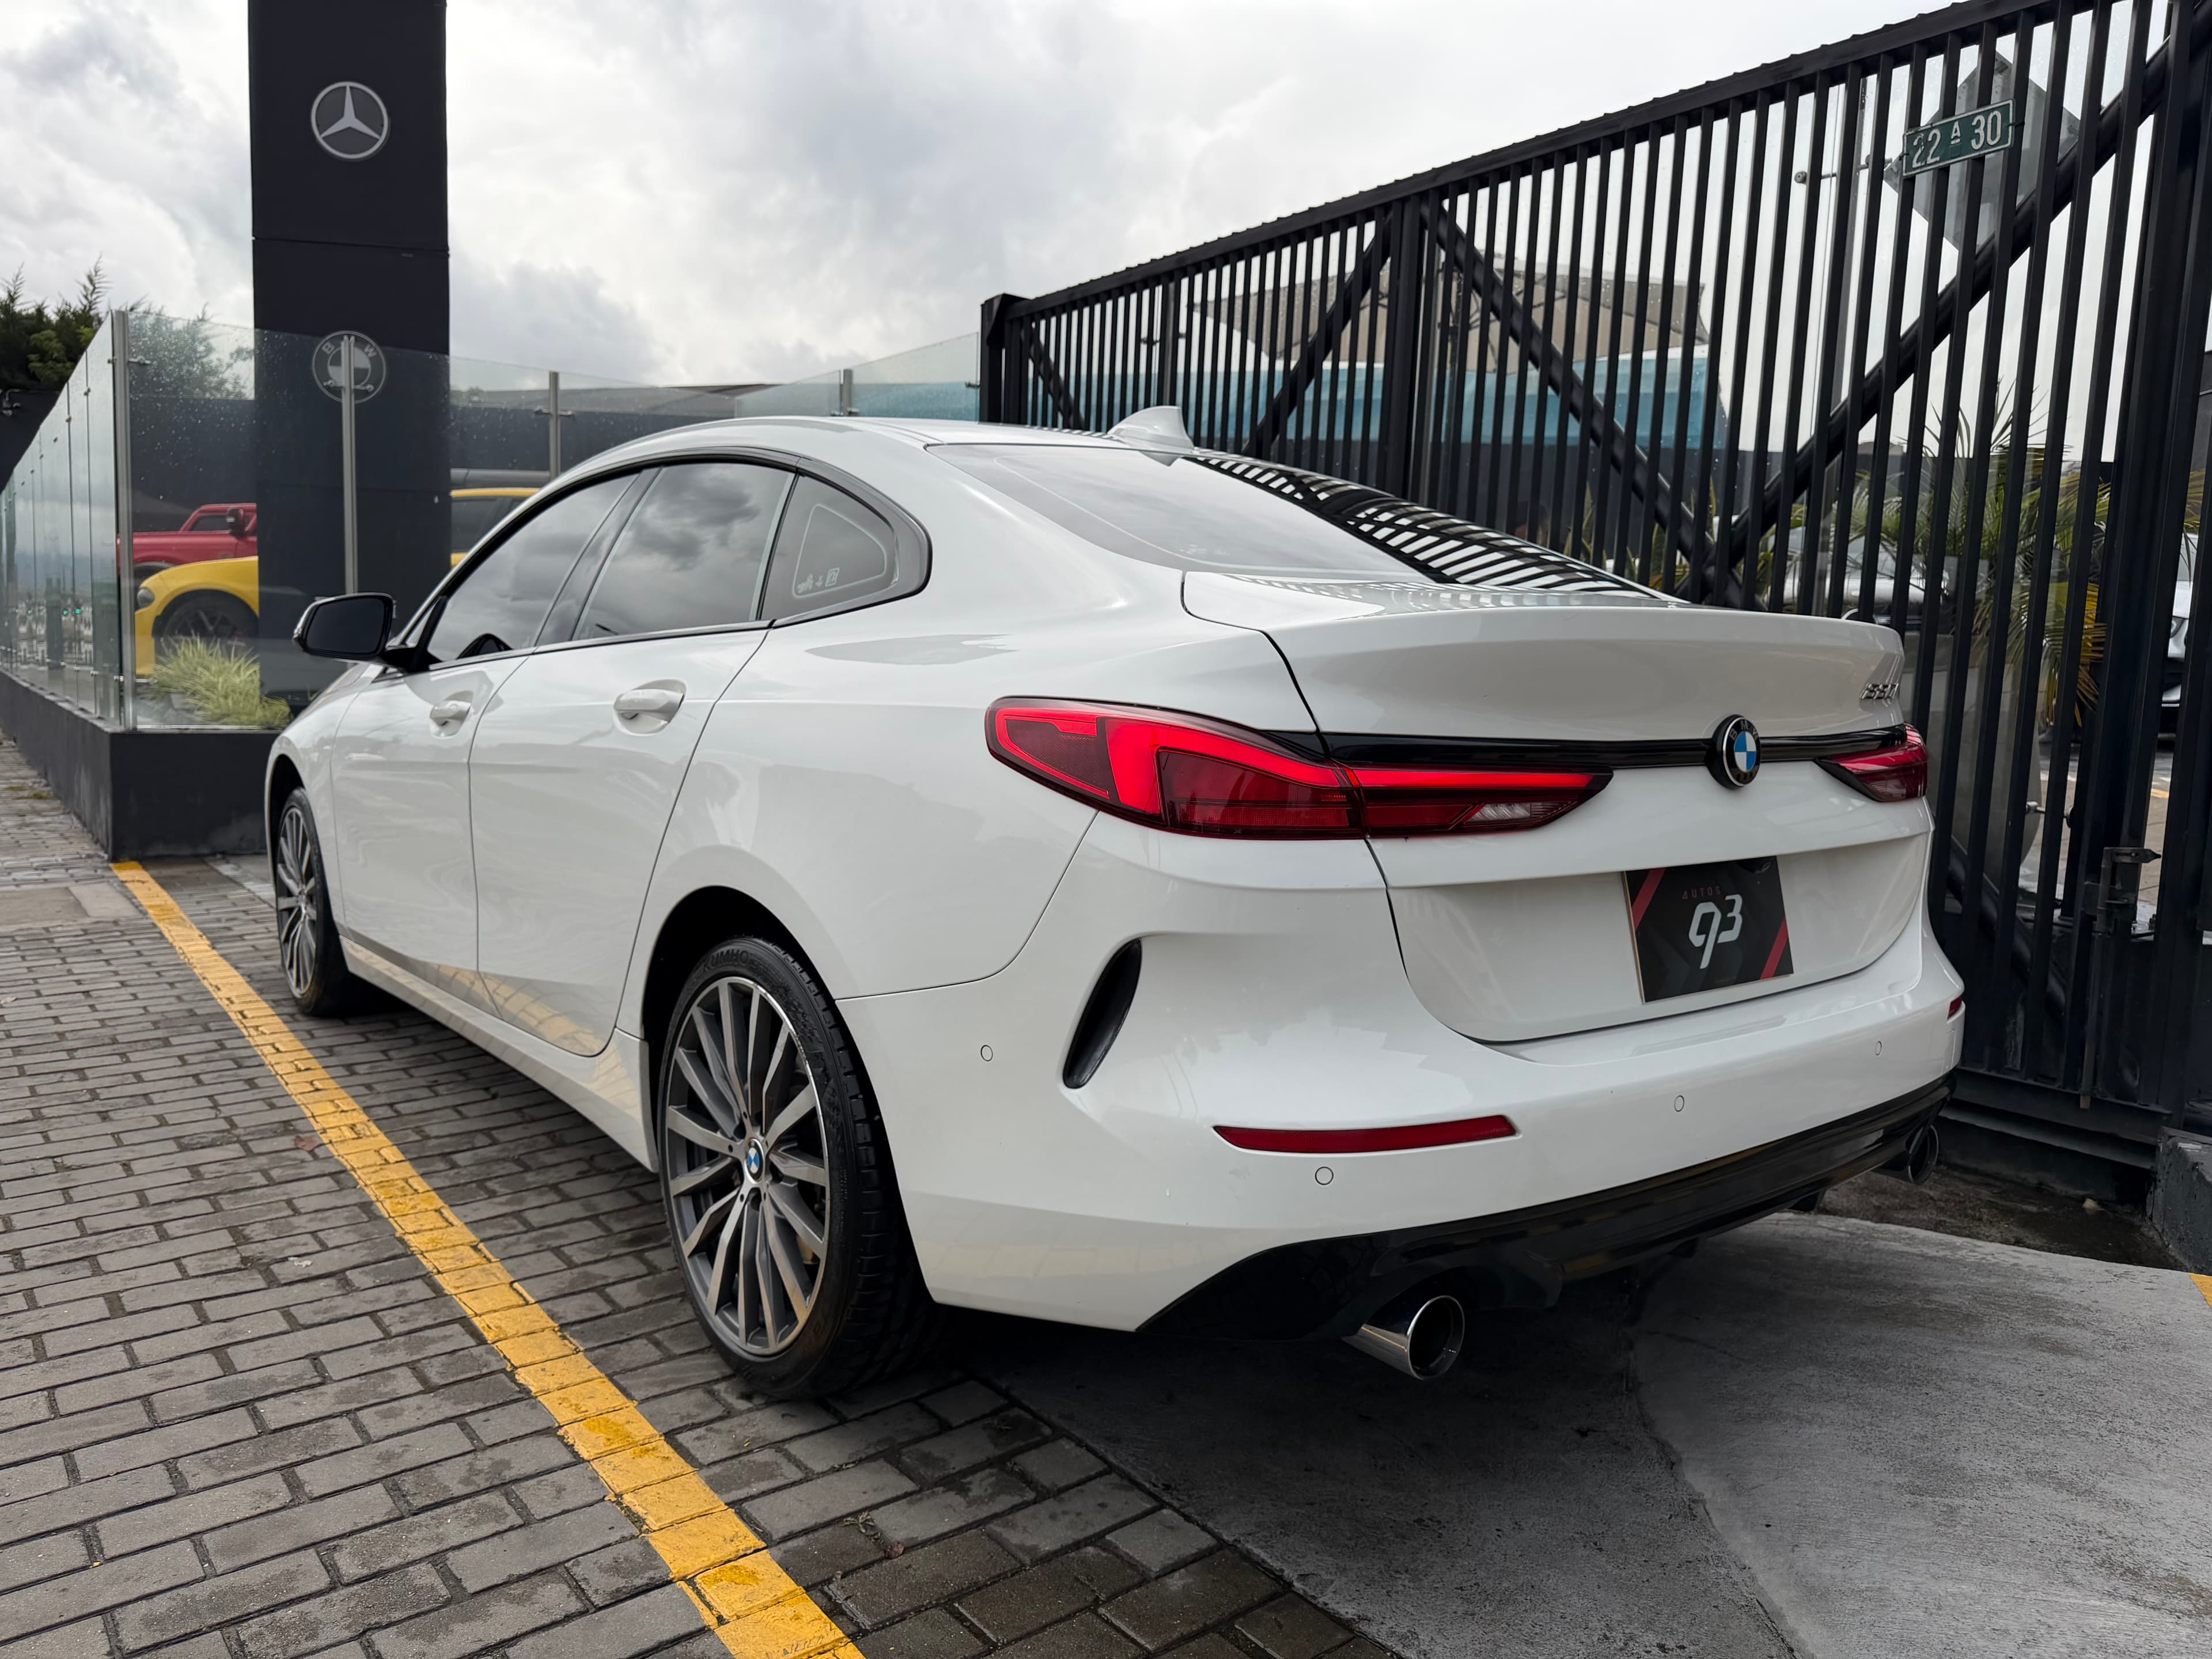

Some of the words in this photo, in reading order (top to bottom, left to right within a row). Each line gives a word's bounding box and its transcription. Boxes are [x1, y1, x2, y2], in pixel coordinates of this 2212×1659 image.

[1912, 128, 1941, 168] 22
[1971, 111, 2002, 150] 30
[1729, 719, 1758, 741] BMW
[1682, 885, 1721, 899] AUTOS
